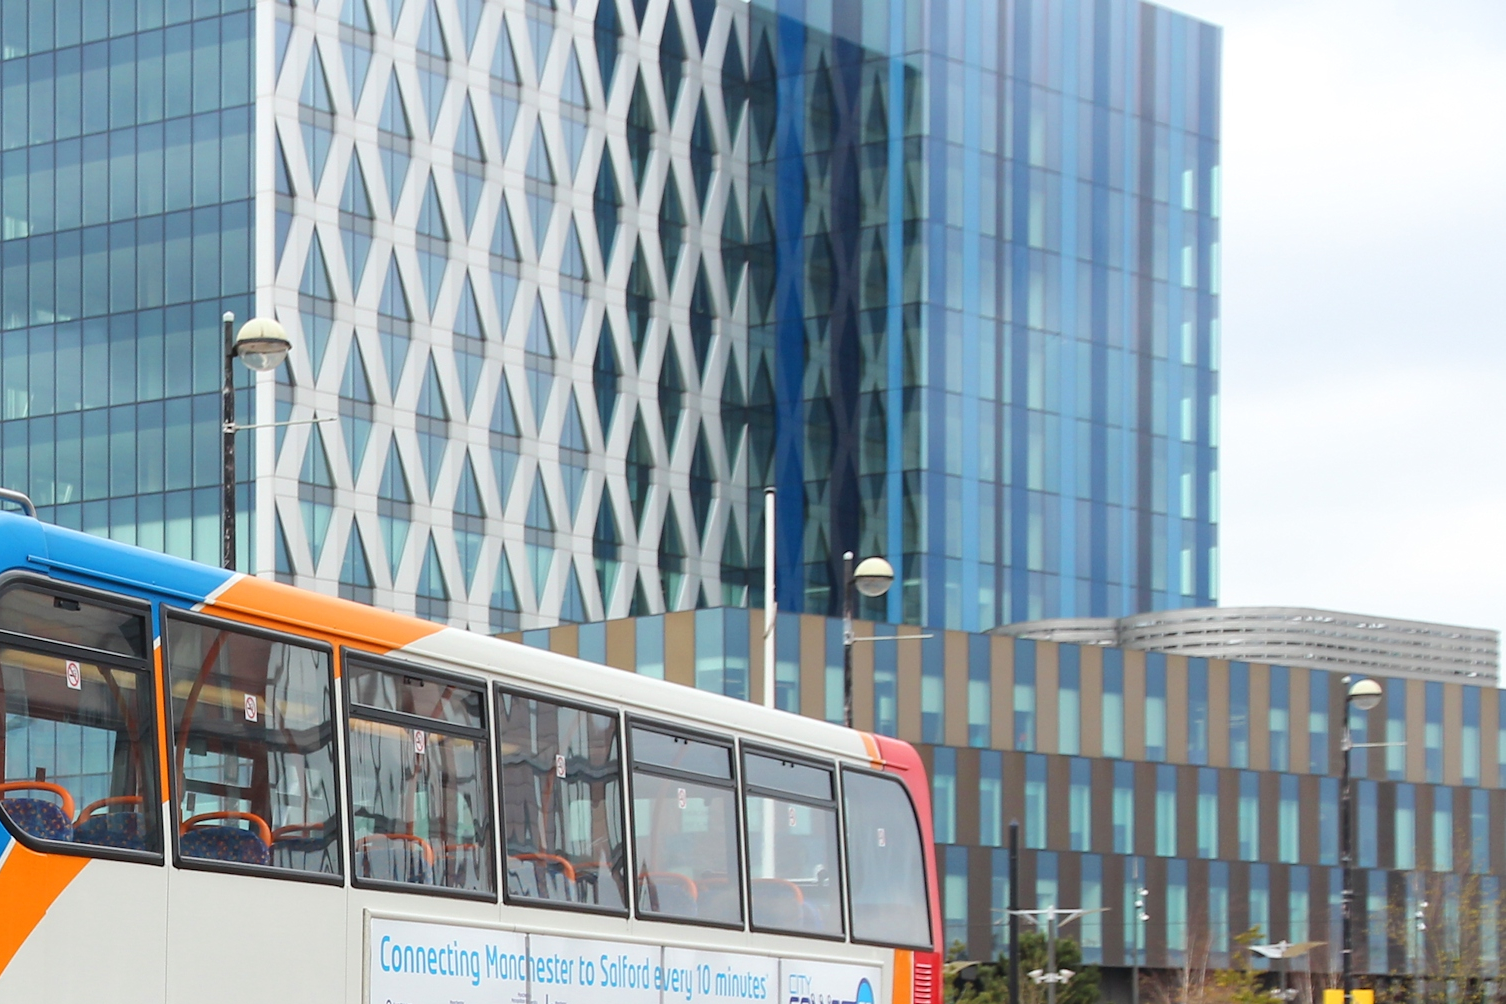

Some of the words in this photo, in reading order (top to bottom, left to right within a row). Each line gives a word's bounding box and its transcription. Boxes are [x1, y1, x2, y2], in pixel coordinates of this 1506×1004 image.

[380, 935, 481, 987] Connecting
[485, 944, 574, 984] Manchester
[579, 956, 594, 986] to
[600, 954, 650, 989] Salford
[654, 966, 692, 1001] every
[697, 964, 710, 995] 10
[789, 974, 812, 995] CITY
